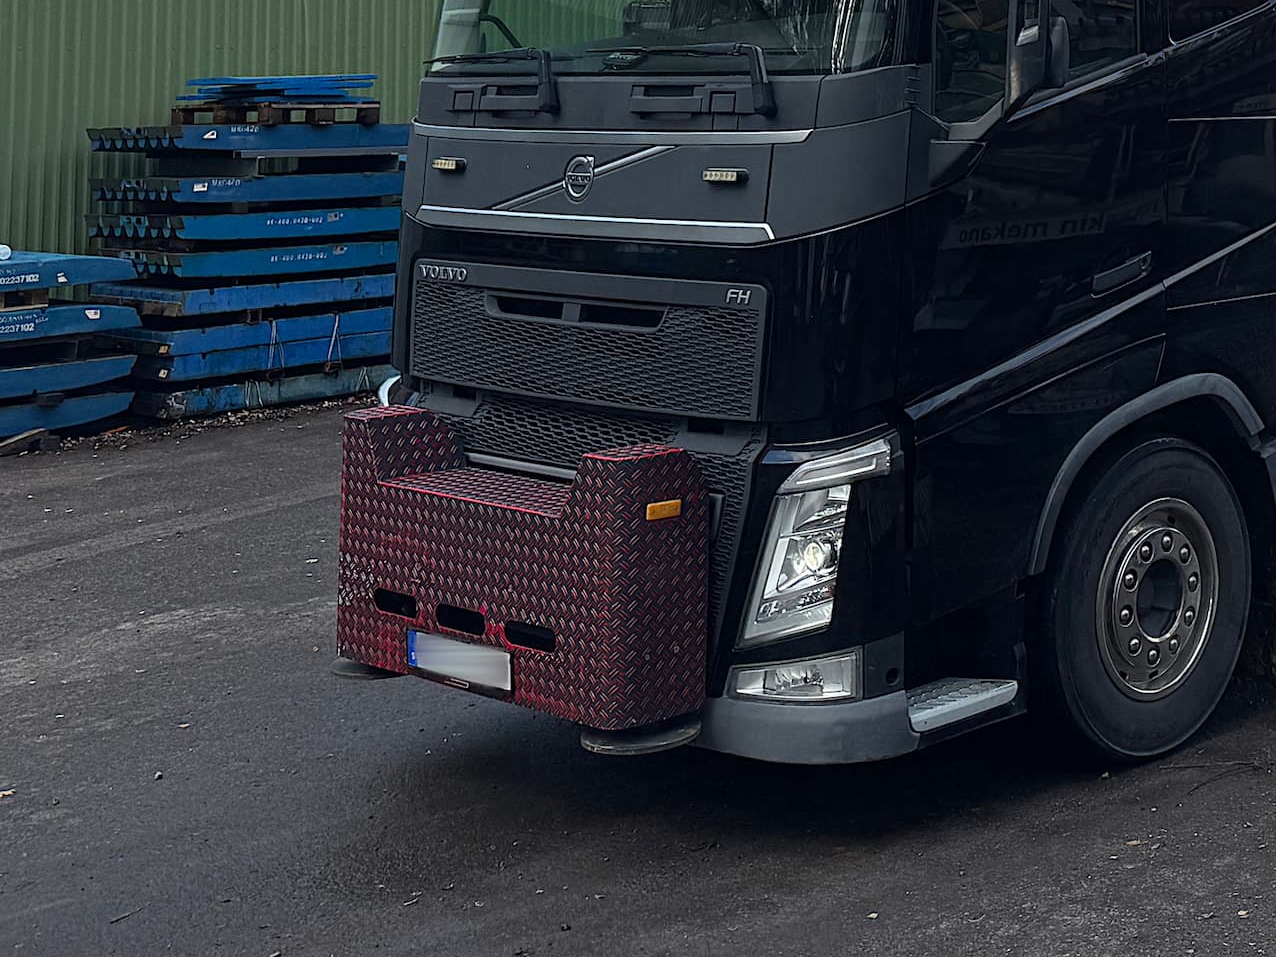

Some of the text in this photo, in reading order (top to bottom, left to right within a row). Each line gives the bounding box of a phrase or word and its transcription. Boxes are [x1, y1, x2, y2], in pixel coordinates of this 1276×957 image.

[567, 175, 592, 183] VOLVO
[419, 264, 467, 282] VOLVO
[725, 288, 751, 304] FH
